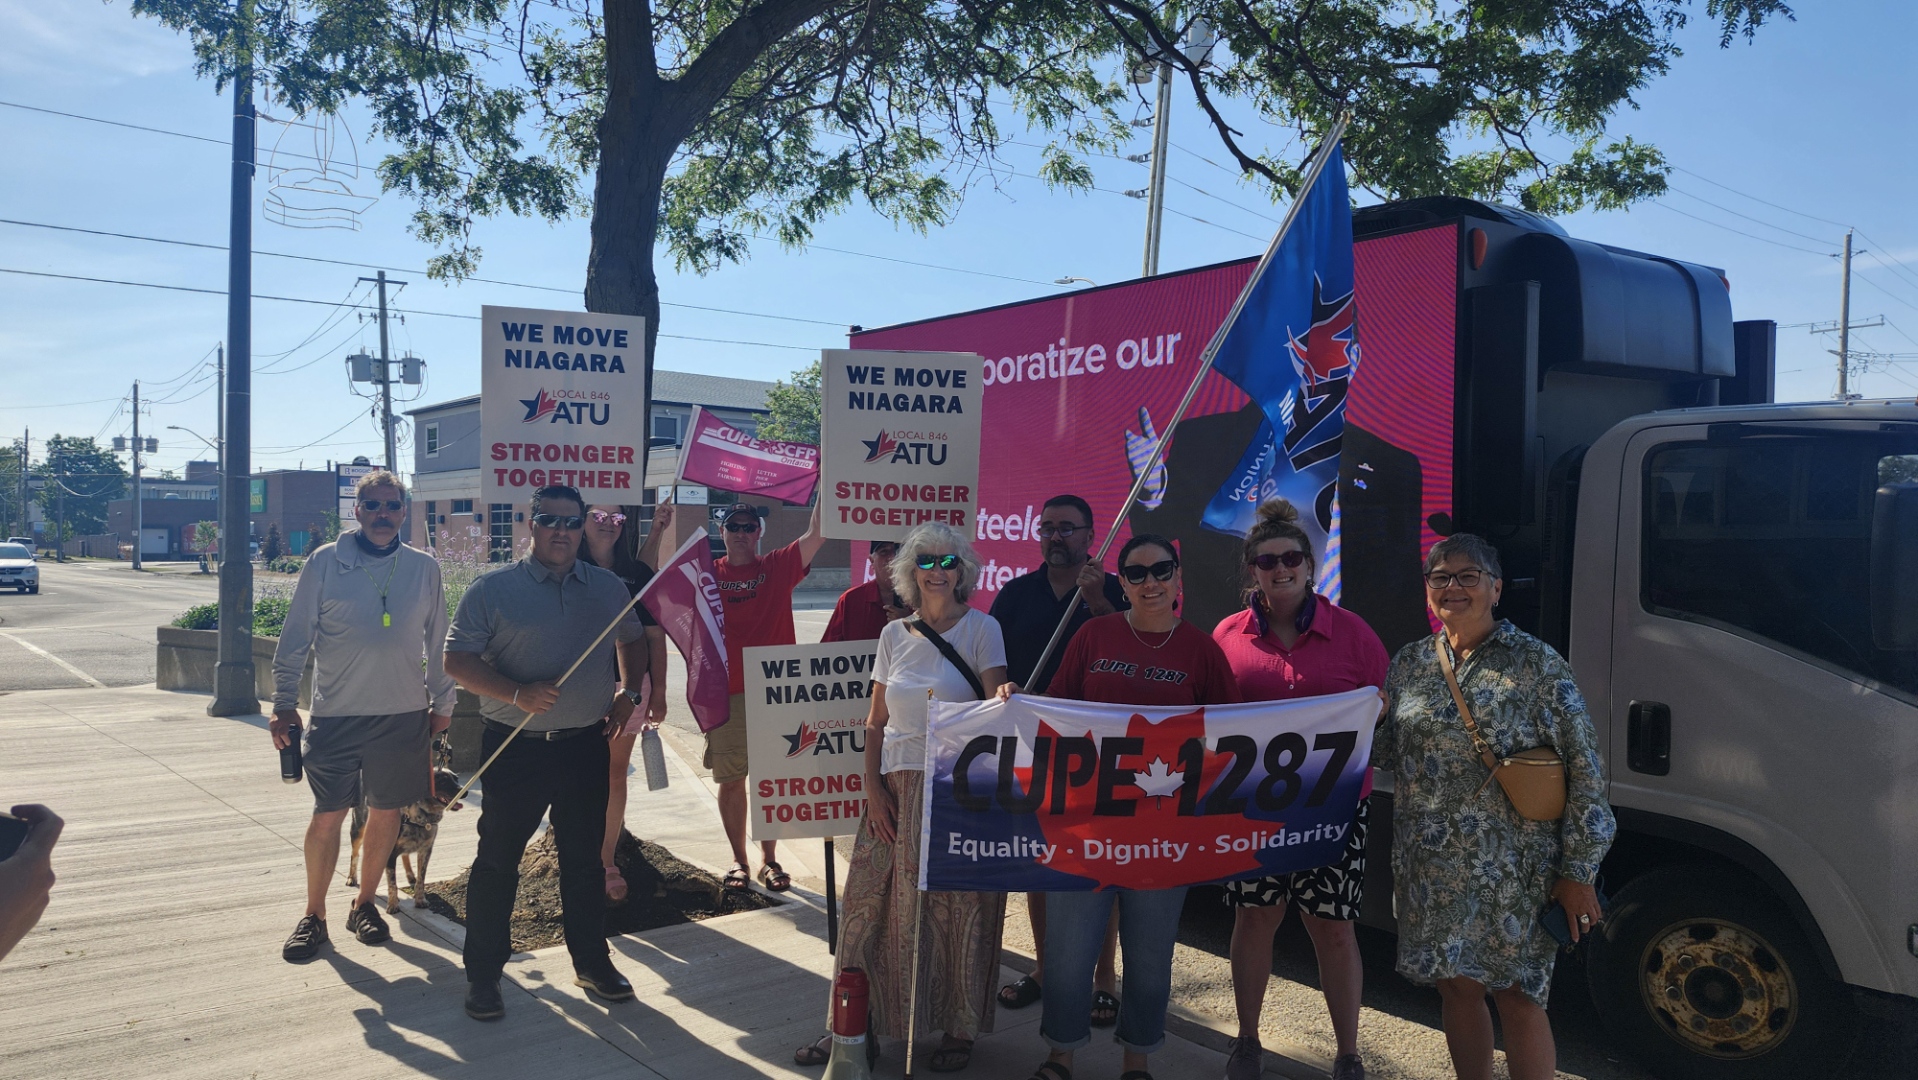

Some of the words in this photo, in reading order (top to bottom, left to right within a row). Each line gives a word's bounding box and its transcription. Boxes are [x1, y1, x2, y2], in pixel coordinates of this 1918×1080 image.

[501, 321, 543, 343] WE
[553, 325, 628, 348] MOVE
[505, 348, 625, 373] NIAGARA
[982, 337, 1107, 388] poratize
[1116, 332, 1182, 370] our
[846, 365, 885, 385] WE
[894, 367, 967, 388] MOVE
[552, 389, 587, 399] LOCAL
[590, 391, 611, 400] 846
[848, 391, 963, 414] NIAGARA
[550, 401, 610, 425] ATU
[715, 426, 760, 449] CUPE
[775, 442, 816, 459] SCFP
[892, 430, 925, 440] LOCAL
[928, 431, 948, 441] 846
[490, 442, 634, 464] STRONGER
[780, 456, 810, 468] Ontario
[890, 442, 947, 465] ATU
[494, 468, 631, 489] TOGETHER
[835, 481, 970, 503] STRONGER
[838, 505, 965, 527] TOGETHER
[698, 571, 725, 628] CUPE
[761, 658, 801, 679] WE
[1090, 658, 1139, 677] CUPE
[1144, 666, 1188, 685] 1287
[813, 719, 846, 730] LOCAL
[813, 730, 867, 756] ATU
[758, 772, 867, 798] STRONG
[952, 734, 1146, 817] CUPE
[1176, 731, 1358, 817] 1287
[762, 798, 869, 823] TOGETH
[948, 832, 1057, 864] Equality
[1083, 838, 1189, 865] Dignity
[1214, 821, 1350, 855] Solidarity
